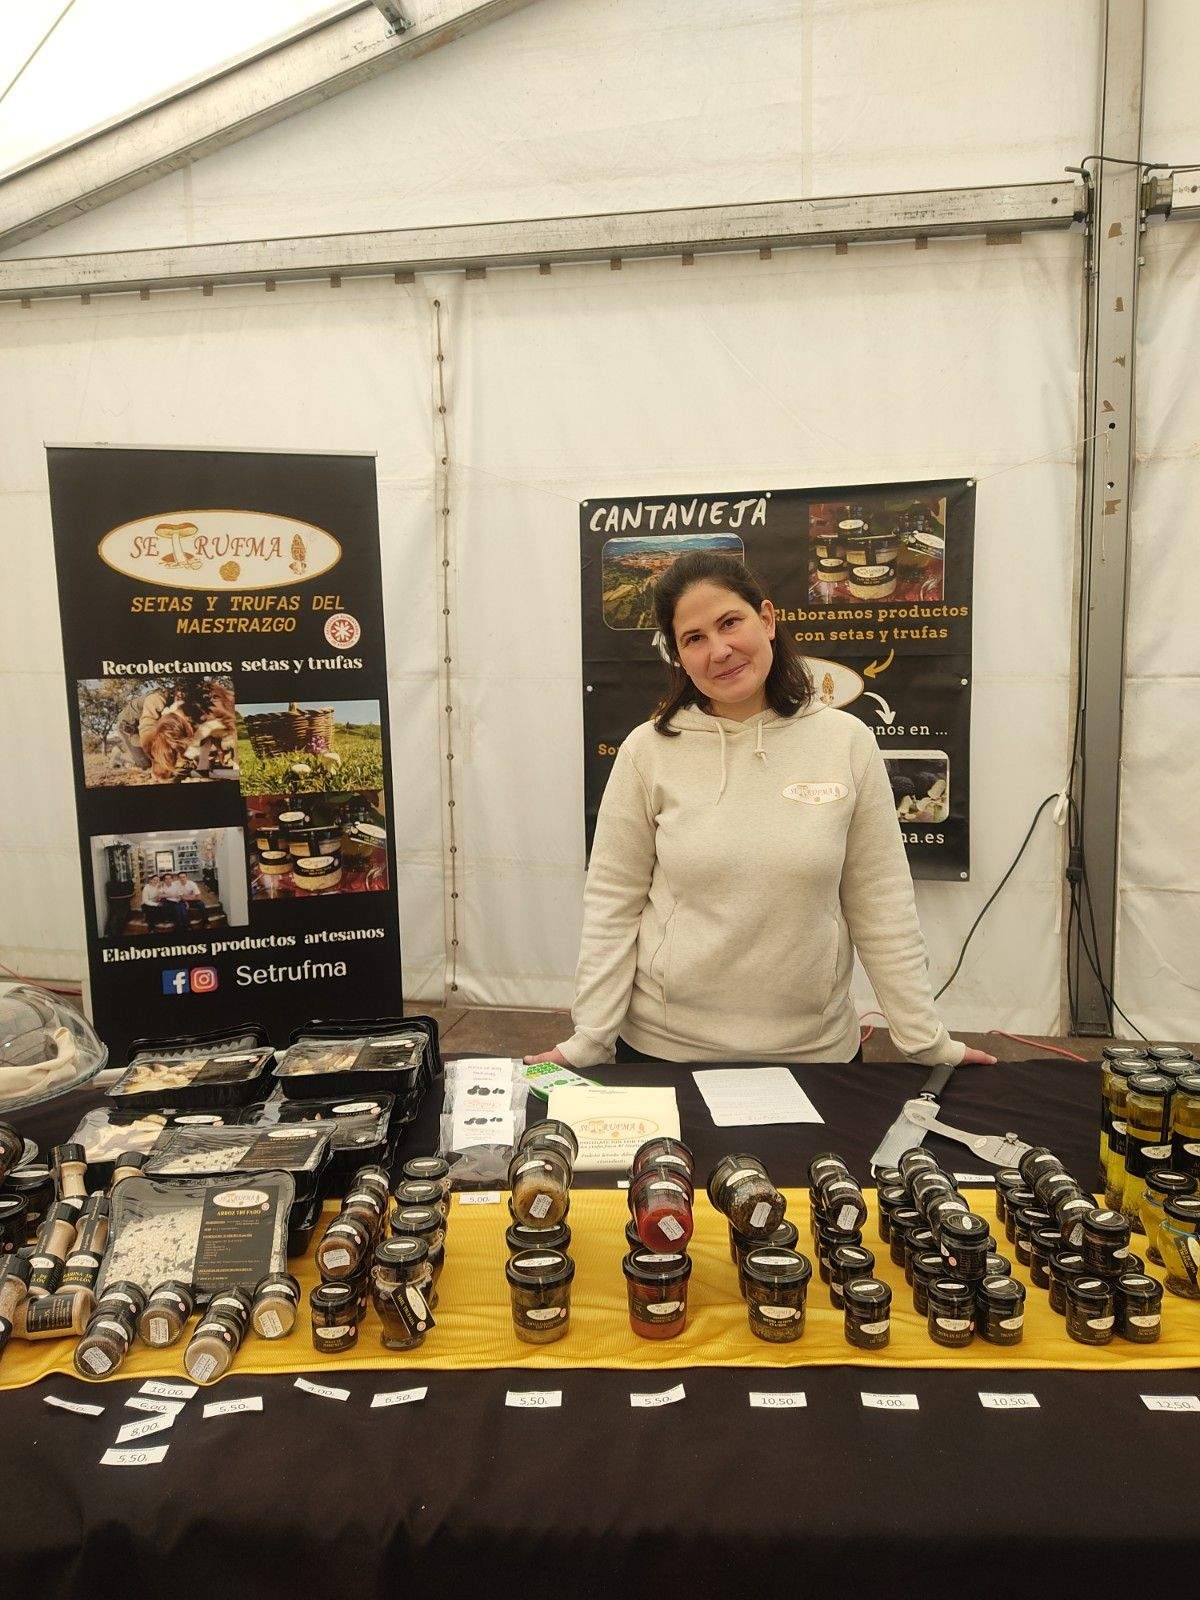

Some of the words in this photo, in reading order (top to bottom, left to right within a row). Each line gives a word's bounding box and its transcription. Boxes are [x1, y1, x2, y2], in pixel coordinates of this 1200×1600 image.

[589, 498, 767, 532] CANTAVIEJA
[131, 597, 193, 612] SETAS
[206, 597, 218, 611] Y
[230, 596, 301, 611] TRUFAS
[312, 596, 345, 610] DEL
[877, 605, 969, 622] productos
[176, 618, 296, 633] MAESTRAZGO
[794, 633, 826, 641] con
[829, 629, 875, 640] setas
[878, 631, 888, 642] y
[893, 626, 948, 640] trufas
[102, 658, 233, 675] Recolectamos
[241, 658, 289, 672] setas
[293, 660, 303, 674] y
[307, 655, 363, 671] trufas
[909, 725, 930, 735] en
[102, 942, 207, 963] Elaboramos
[211, 934, 297, 956] productos
[304, 927, 385, 945] artesanos
[236, 959, 348, 986] Setrufma
